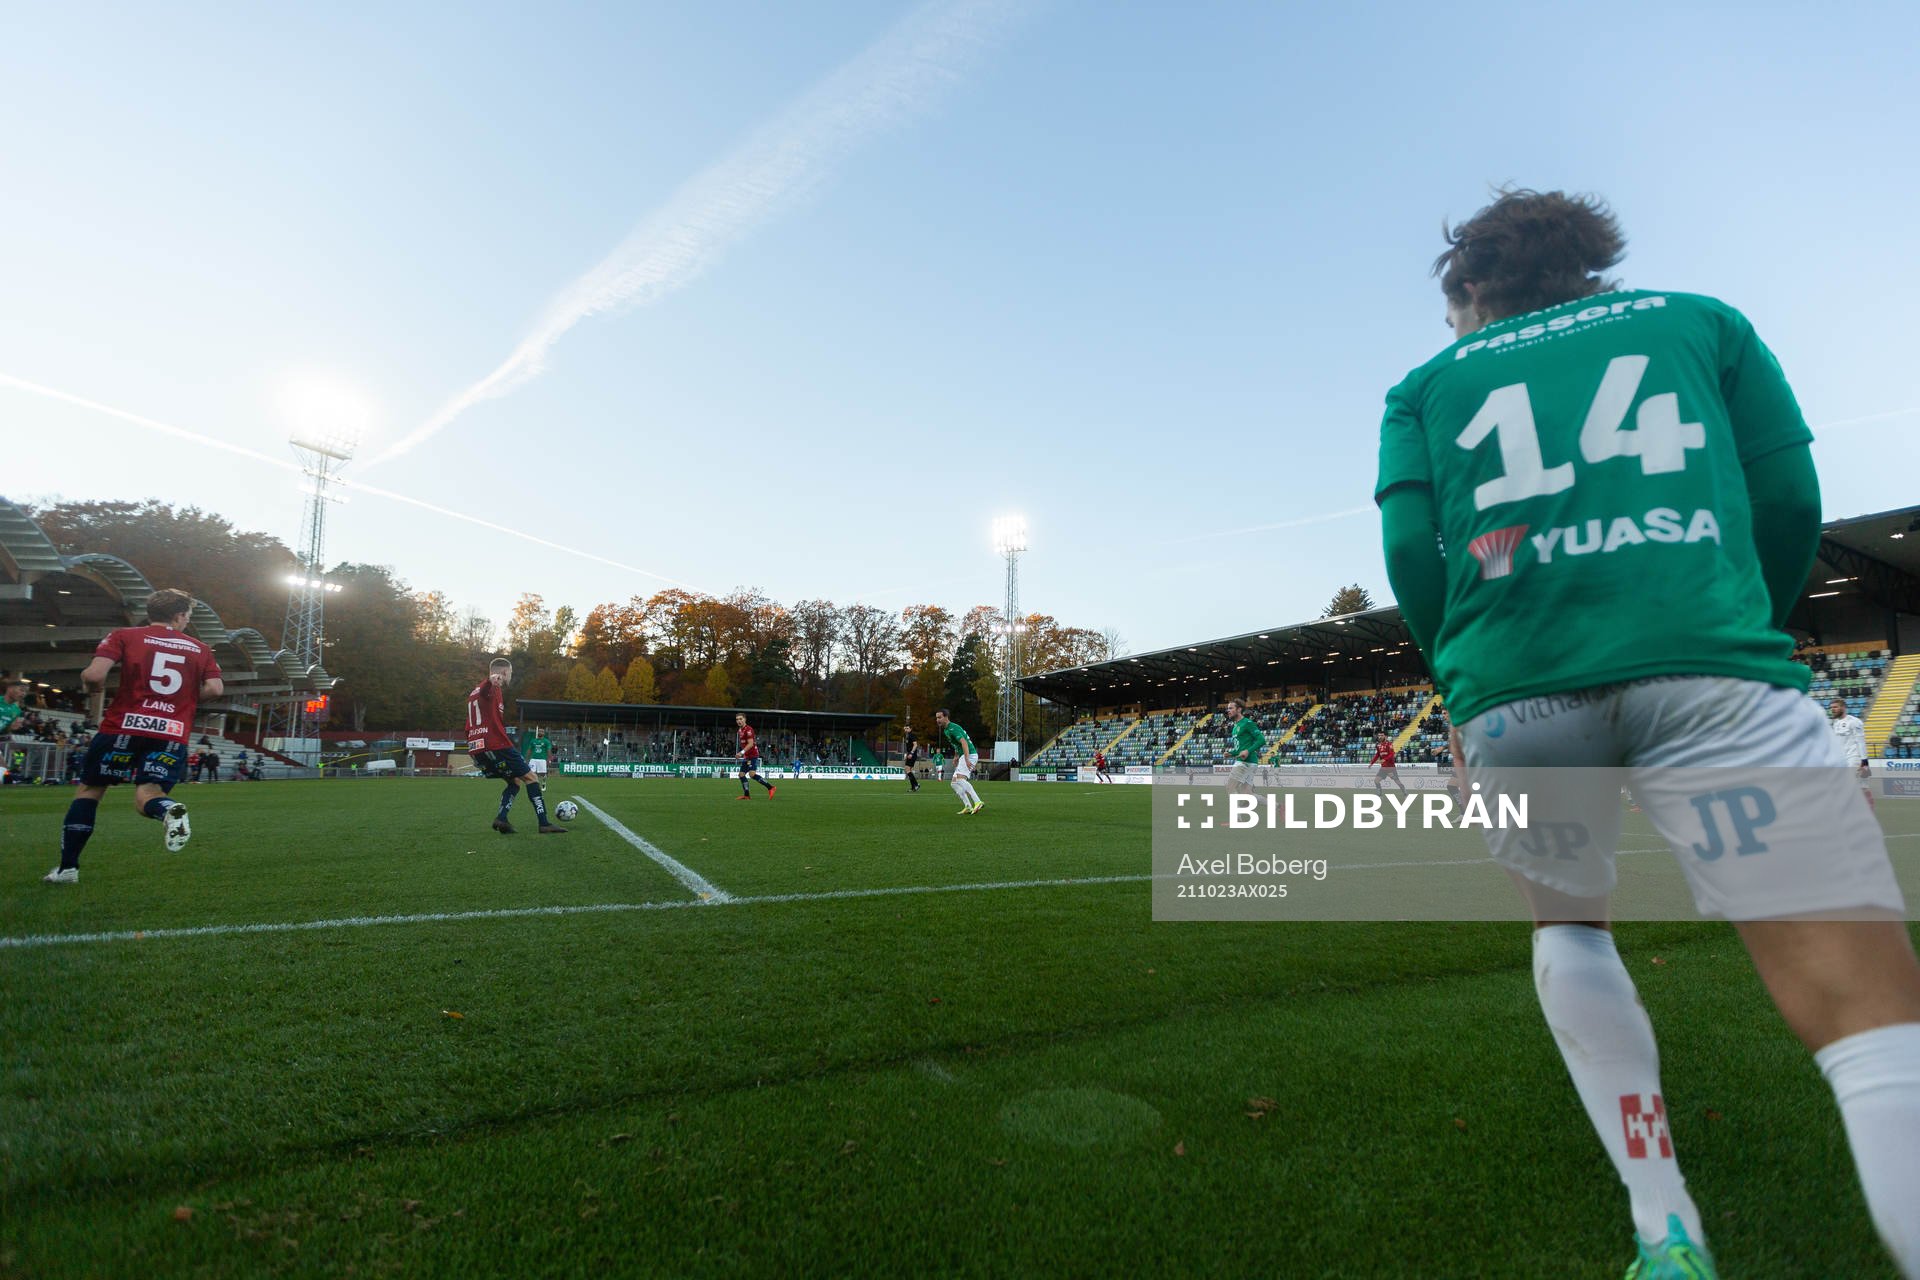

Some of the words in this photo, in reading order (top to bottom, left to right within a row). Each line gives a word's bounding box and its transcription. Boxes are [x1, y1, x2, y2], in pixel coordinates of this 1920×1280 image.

[1558, 314, 1632, 337] SOLUTIONS
[1455, 355, 1706, 512] 14
[1530, 507, 1721, 564] YUASA
[149, 651, 186, 695] 5
[124, 714, 167, 732] BESAB
[142, 699, 176, 713] LANS
[468, 700, 482, 727] 11
[563, 762, 594, 773] RÄDDA
[597, 764, 632, 773] SVENSK
[634, 765, 669, 773] FOTBOLL
[1689, 785, 1778, 862] JP
[1519, 820, 1590, 862] JP
